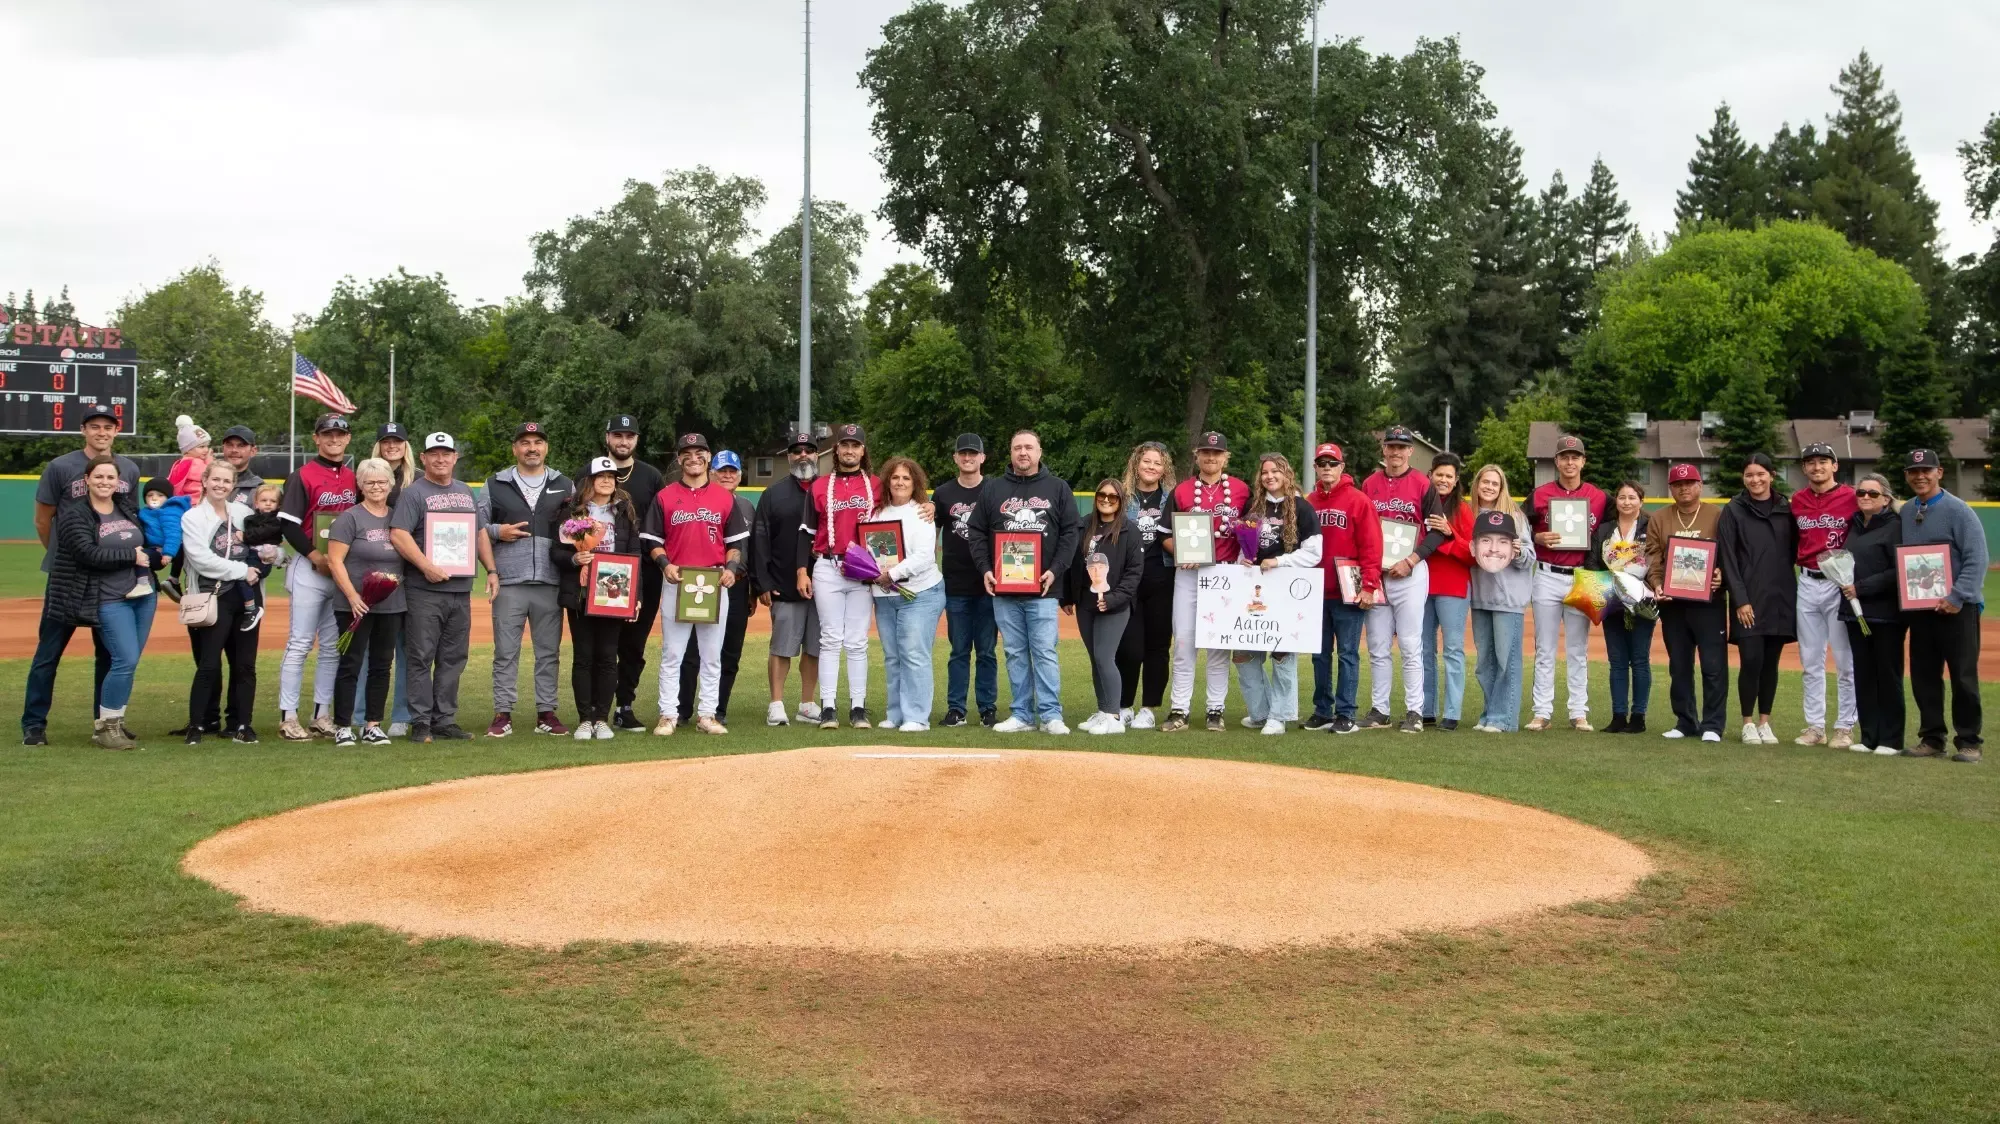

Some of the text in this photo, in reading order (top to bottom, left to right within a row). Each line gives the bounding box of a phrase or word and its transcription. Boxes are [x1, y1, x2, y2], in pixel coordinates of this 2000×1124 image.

[14, 324, 121, 349] STATE
[0, 348, 20, 357] epsi
[49, 364, 68, 374] OUT
[107, 367, 122, 376] H/E
[53, 374, 64, 390] 0
[43, 394, 65, 403] RUNS
[79, 396, 97, 404] HITS
[111, 396, 127, 405] ERR
[54, 403, 63, 416] 0
[54, 418, 63, 430] 0
[435, 434, 446, 443] C
[602, 460, 611, 468] C
[1388, 498, 1416, 513] State
[671, 508, 721, 525] Chico State
[1318, 512, 1347, 530] ICO
[1488, 511, 1503, 525] C
[1007, 520, 1047, 531] McCurley
[708, 526, 717, 544] 5
[1142, 532, 1155, 541] 28
[1199, 576, 1231, 591] #28
[1234, 616, 1280, 632] Aaron
